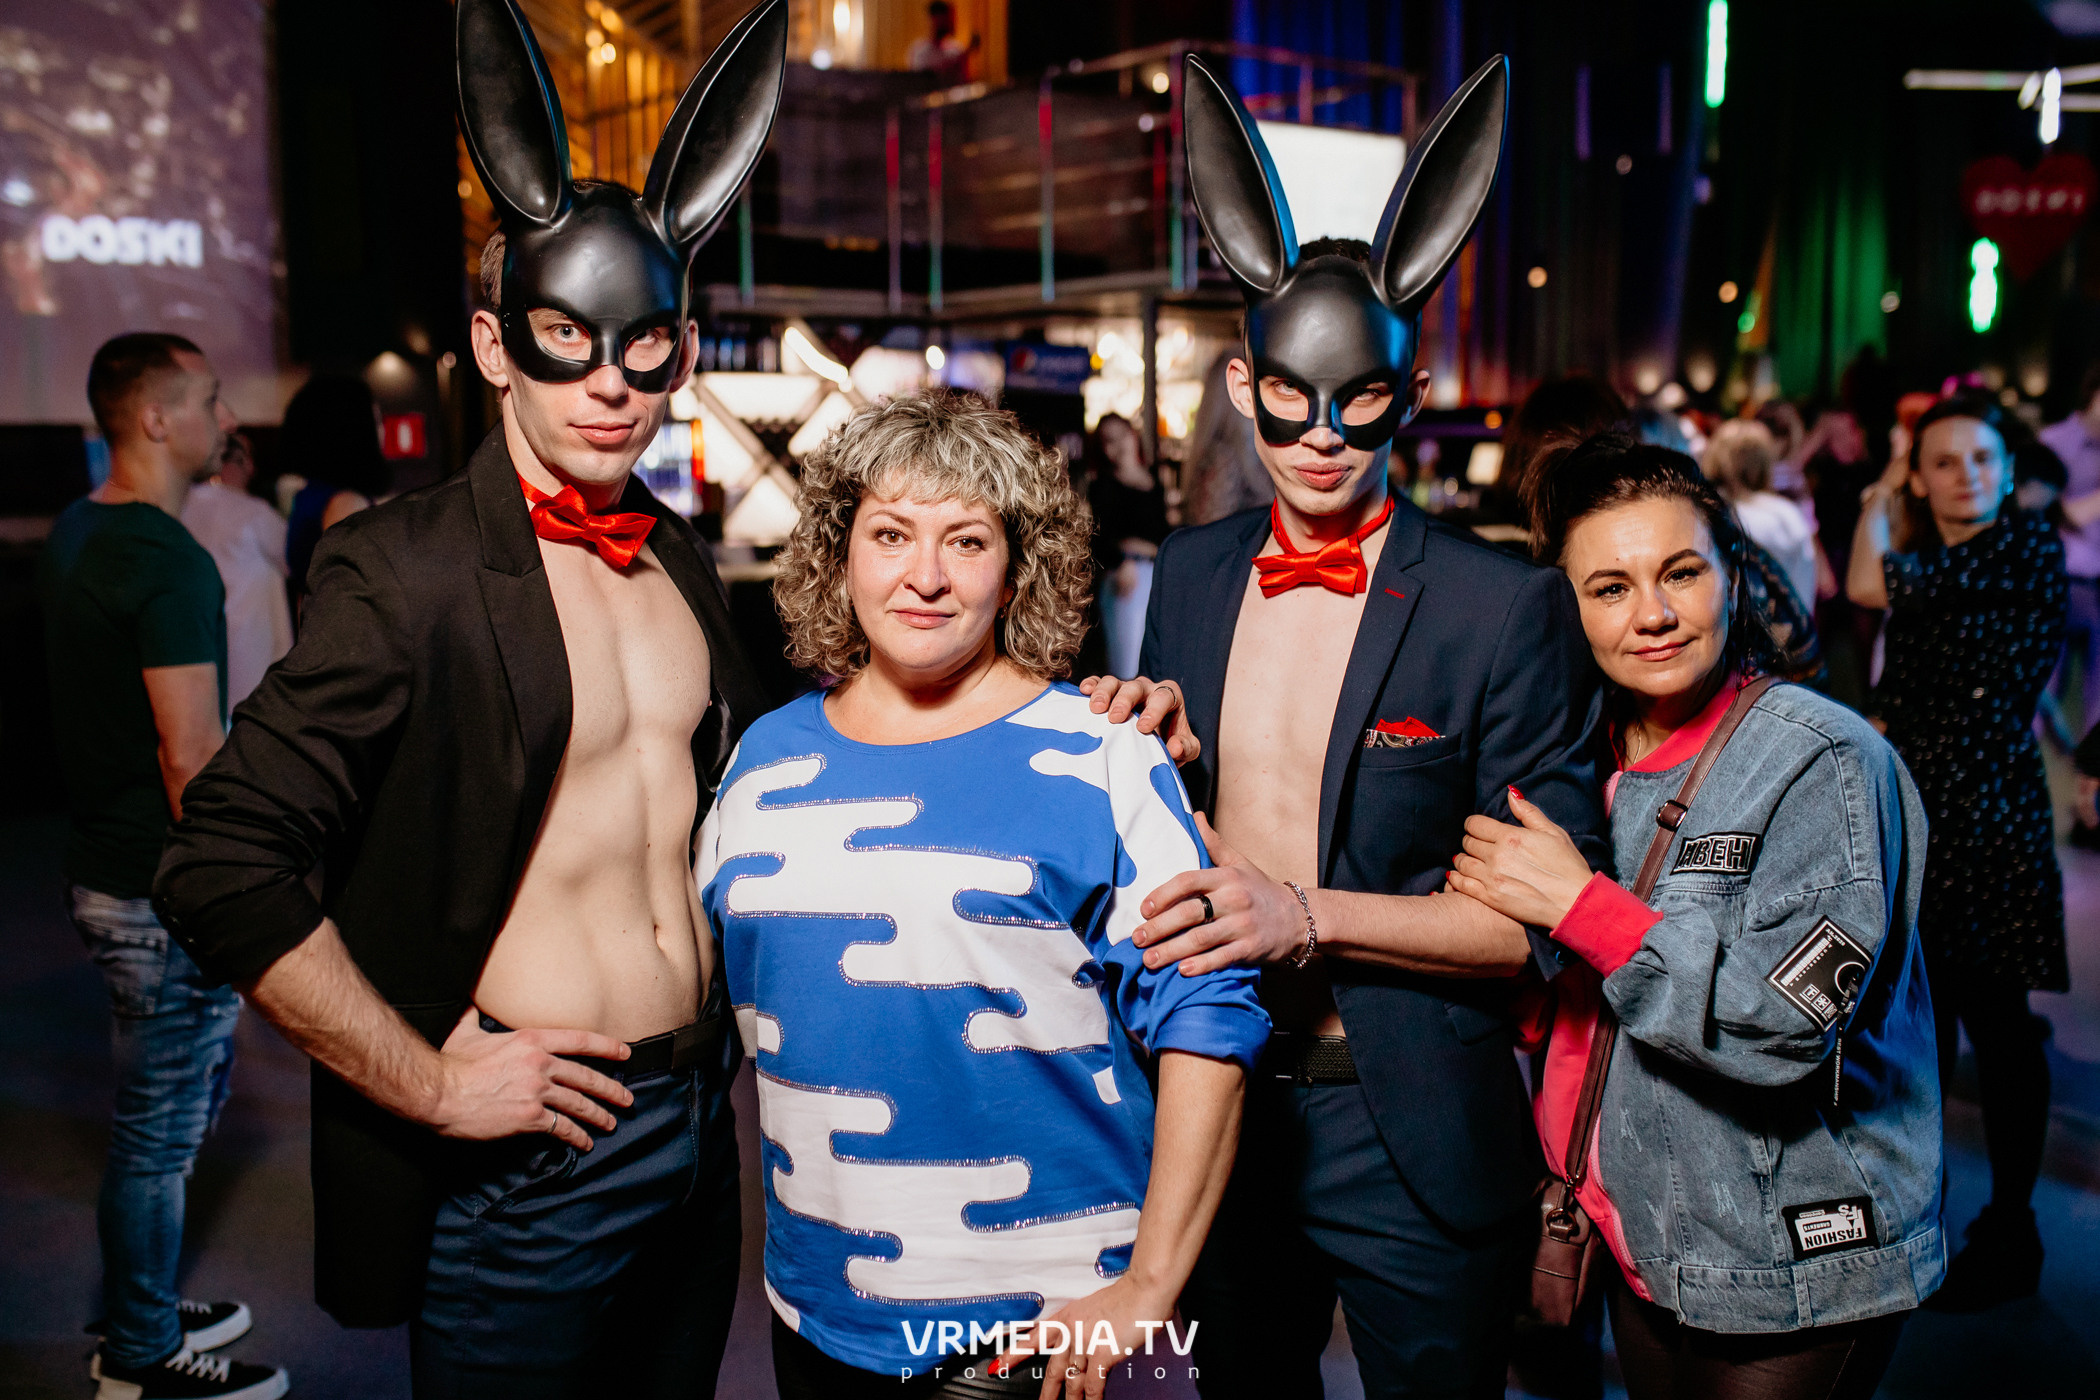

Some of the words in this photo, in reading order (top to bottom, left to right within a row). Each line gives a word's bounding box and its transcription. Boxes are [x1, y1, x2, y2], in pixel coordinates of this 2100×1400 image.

[42, 214, 203, 268] DOSKI
[1838, 1204, 1859, 1220] FS
[1804, 1227, 1863, 1249] FASHION
